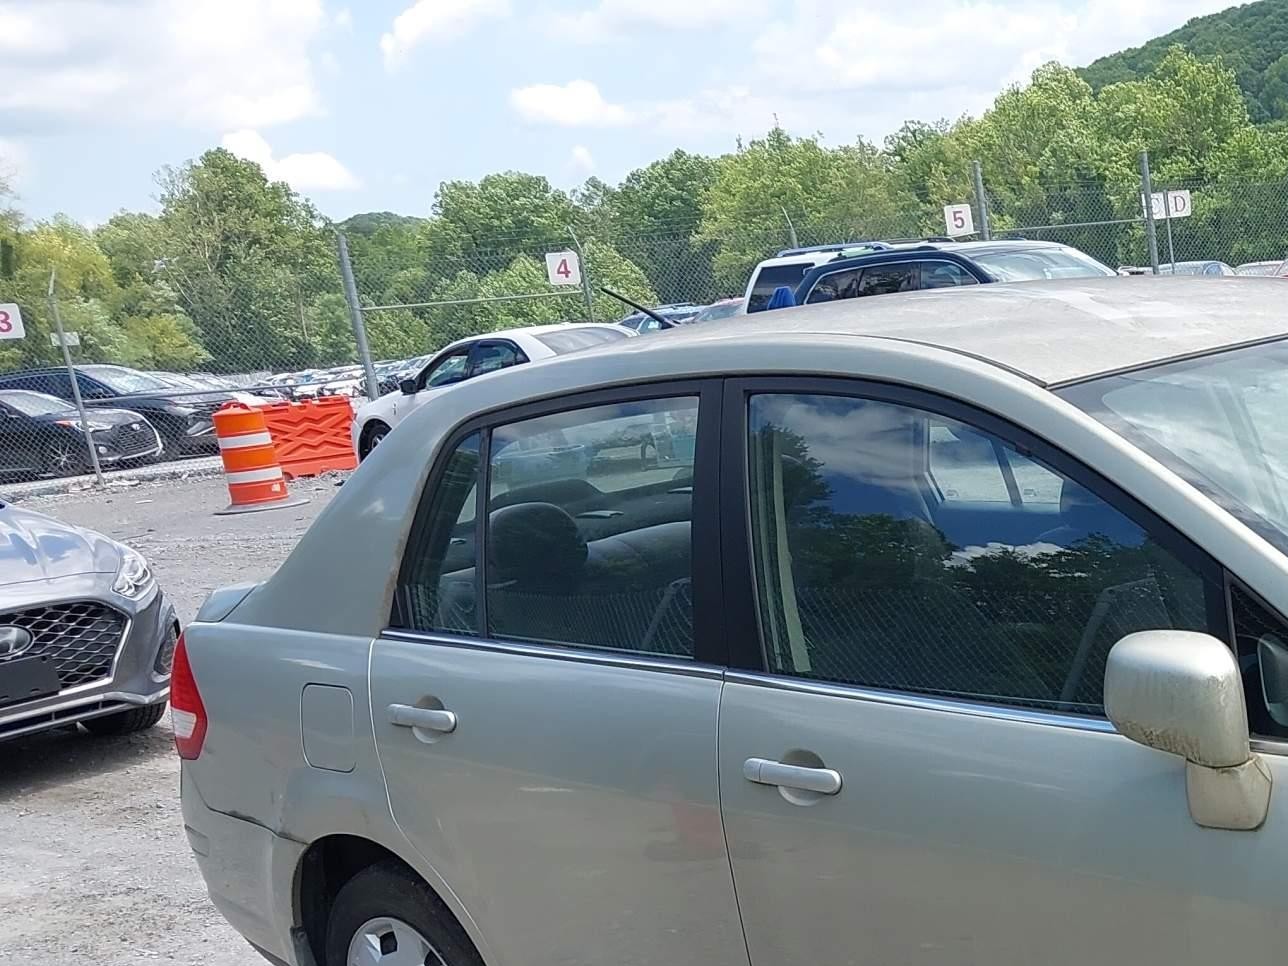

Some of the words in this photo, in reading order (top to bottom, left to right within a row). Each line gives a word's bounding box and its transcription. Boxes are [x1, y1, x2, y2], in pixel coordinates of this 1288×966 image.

[1174, 195, 1186, 212] D
[952, 210, 965, 229] 5
[556, 258, 572, 278] 4
[0, 310, 13, 333] 3
